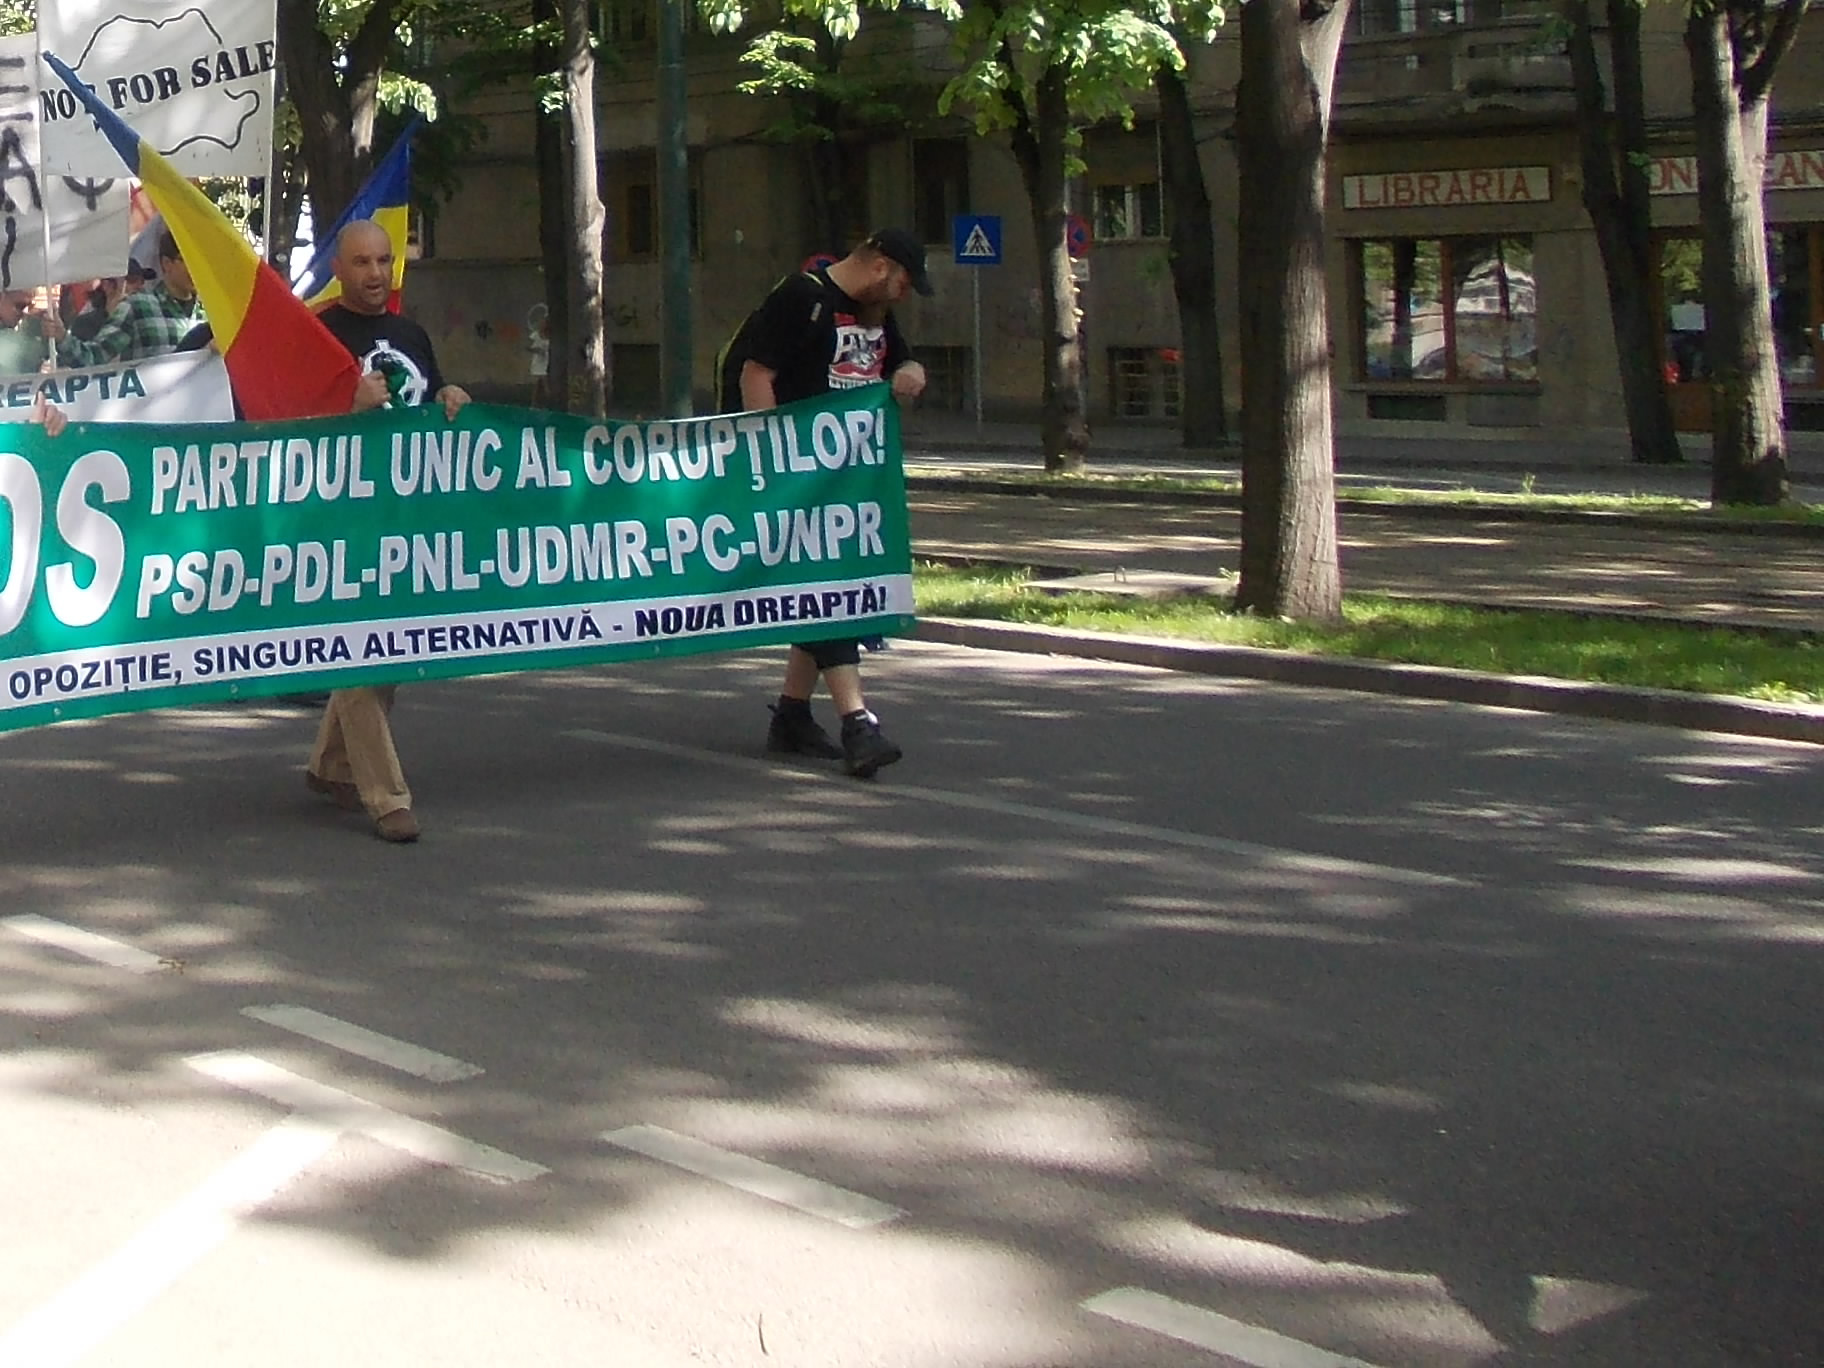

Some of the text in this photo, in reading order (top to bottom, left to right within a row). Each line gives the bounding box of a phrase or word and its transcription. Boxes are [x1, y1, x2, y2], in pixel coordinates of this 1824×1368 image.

[40, 39, 275, 123] NO FOR SALE
[150, 434, 375, 515] PARTIDUL
[390, 428, 503, 497] UNIC
[514, 426, 573, 490] AL
[136, 501, 885, 619] PSD-PDL-PNL-UDMR-PC-UNPR
[193, 635, 352, 676] SINGURA
[362, 609, 603, 659] ALTERNATIVĂ
[634, 602, 726, 637] NOUA
[732, 582, 887, 627] DREAPTĂ!
